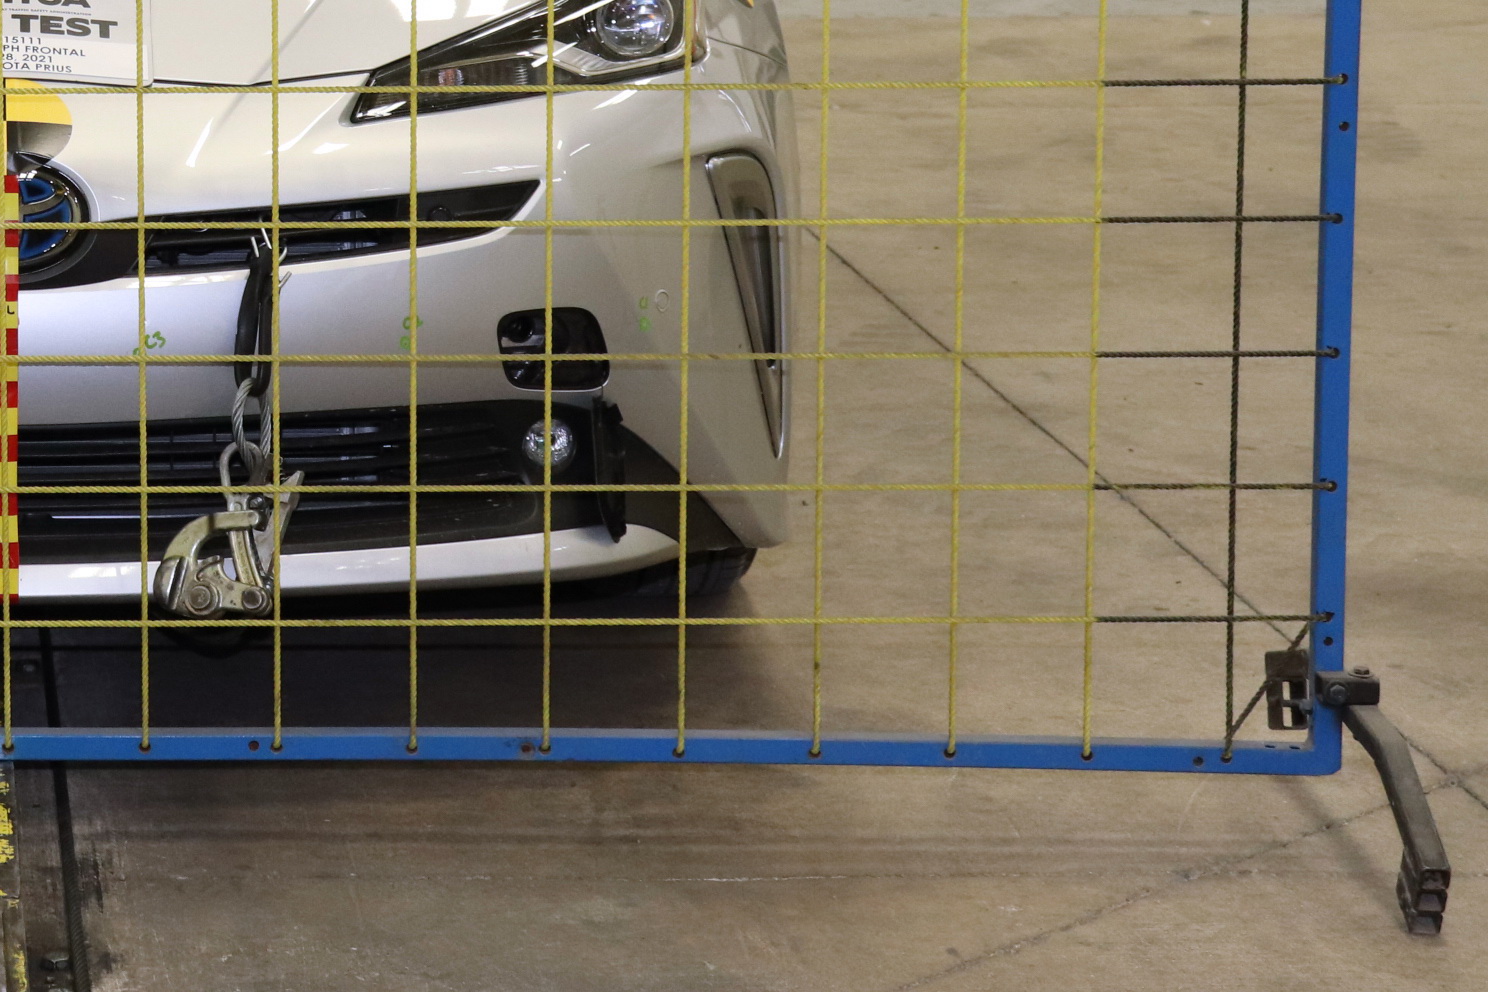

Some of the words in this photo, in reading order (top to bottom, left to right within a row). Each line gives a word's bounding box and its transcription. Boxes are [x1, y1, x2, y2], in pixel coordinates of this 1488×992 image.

[11, 14, 119, 39] TEST
[25, 45, 87, 57] FRONTAL
[22, 54, 53, 63] 2021
[35, 64, 73, 73] PRIUS
